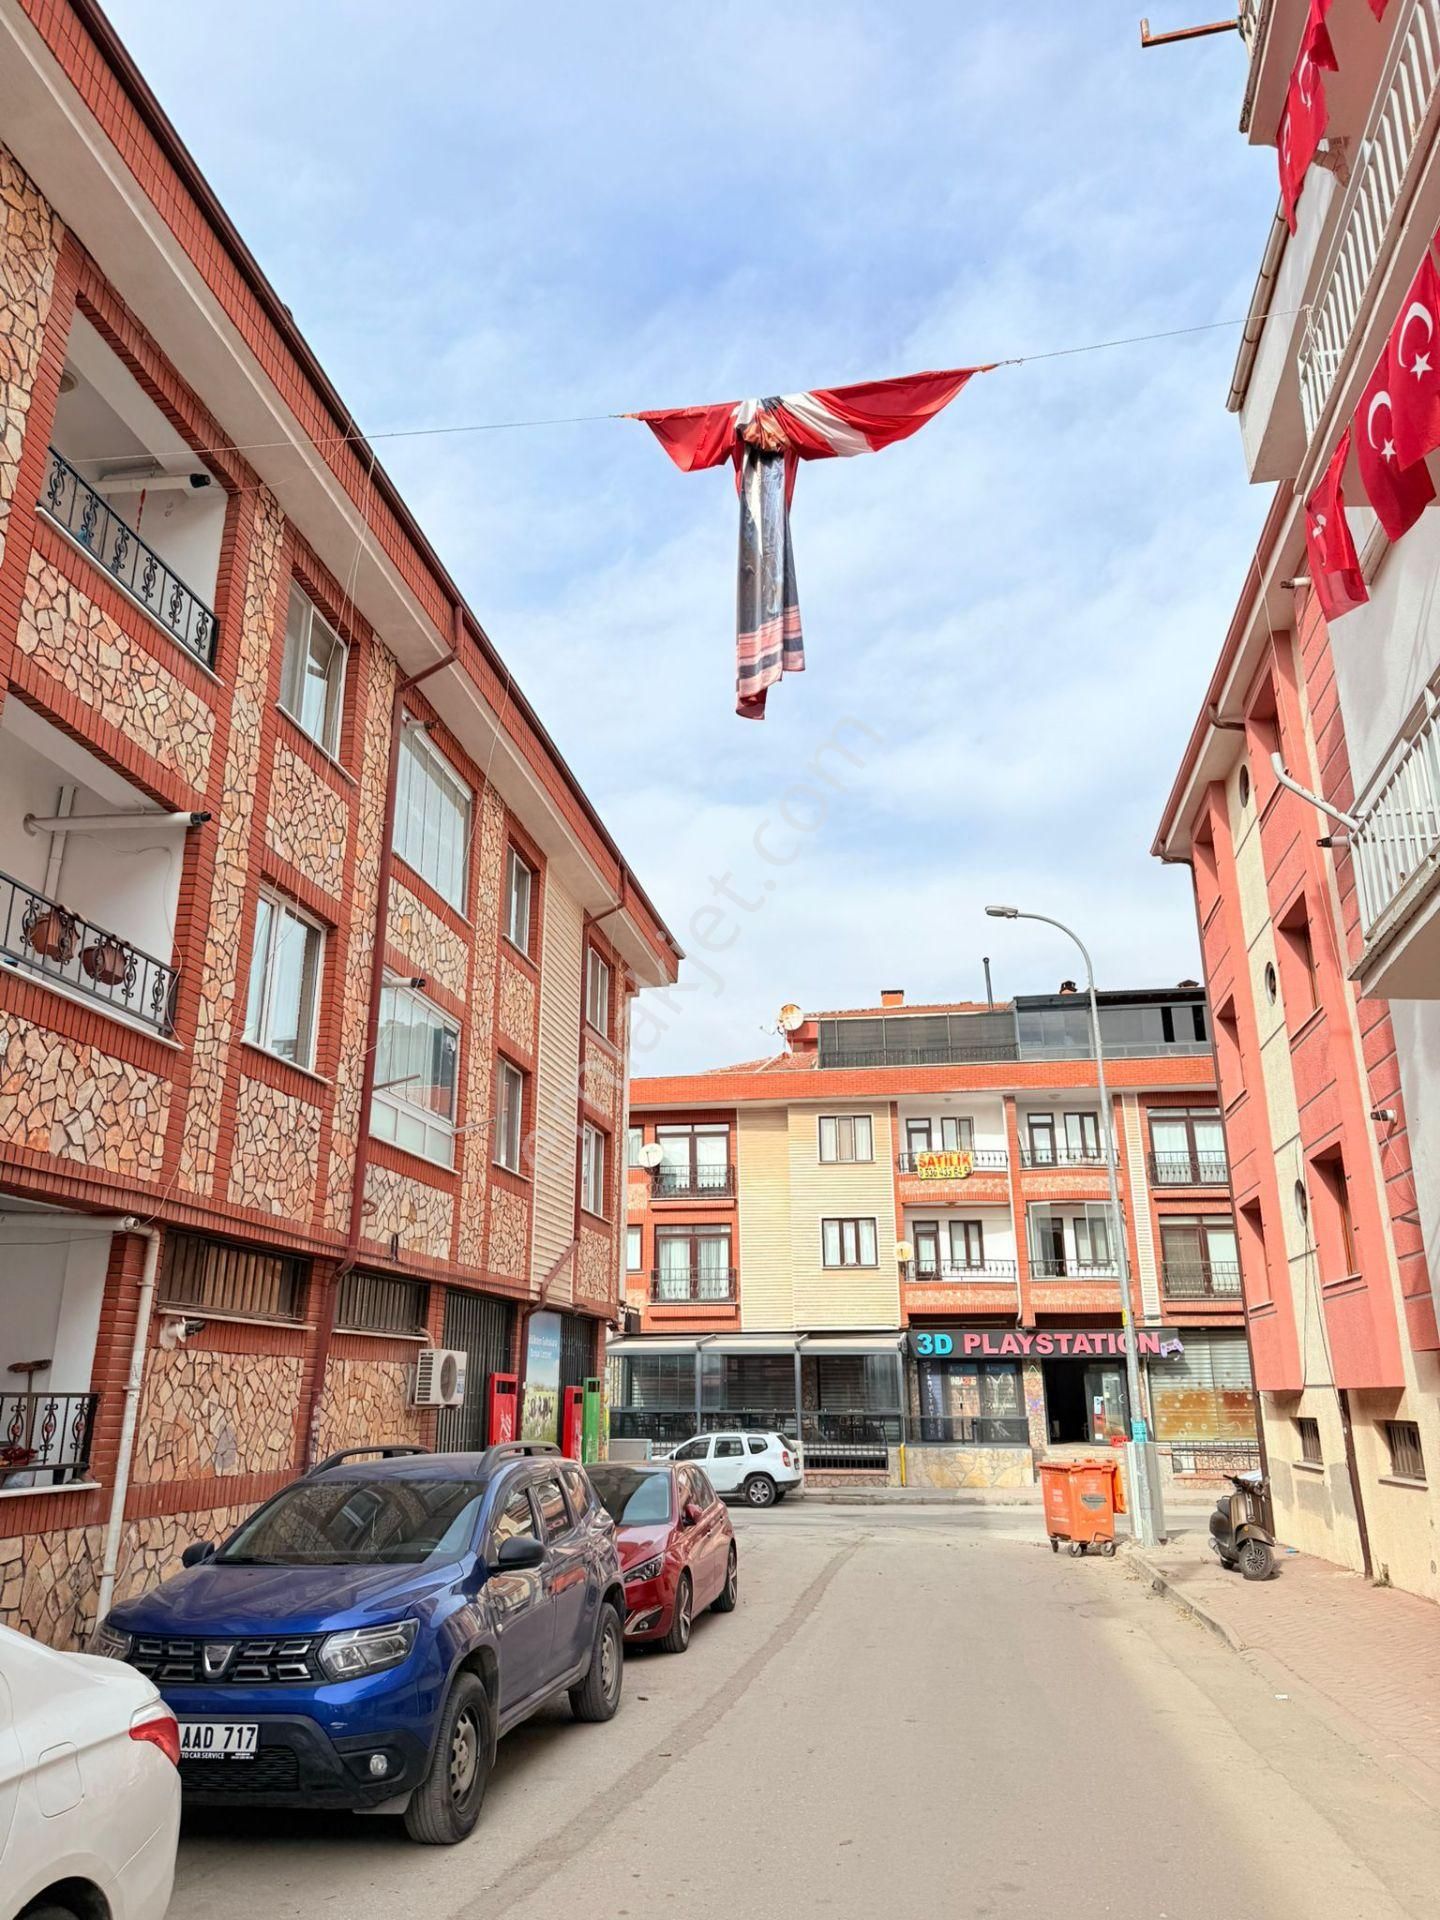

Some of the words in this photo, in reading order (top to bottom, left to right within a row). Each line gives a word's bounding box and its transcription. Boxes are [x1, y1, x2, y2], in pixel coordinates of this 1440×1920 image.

[917, 1333, 954, 1356] 3D
[963, 1333, 1160, 1356] PLAYSTATION
[182, 1726, 214, 1749] AAD
[224, 1727, 257, 1750] 717
[201, 1752, 225, 1760] SERVICE
